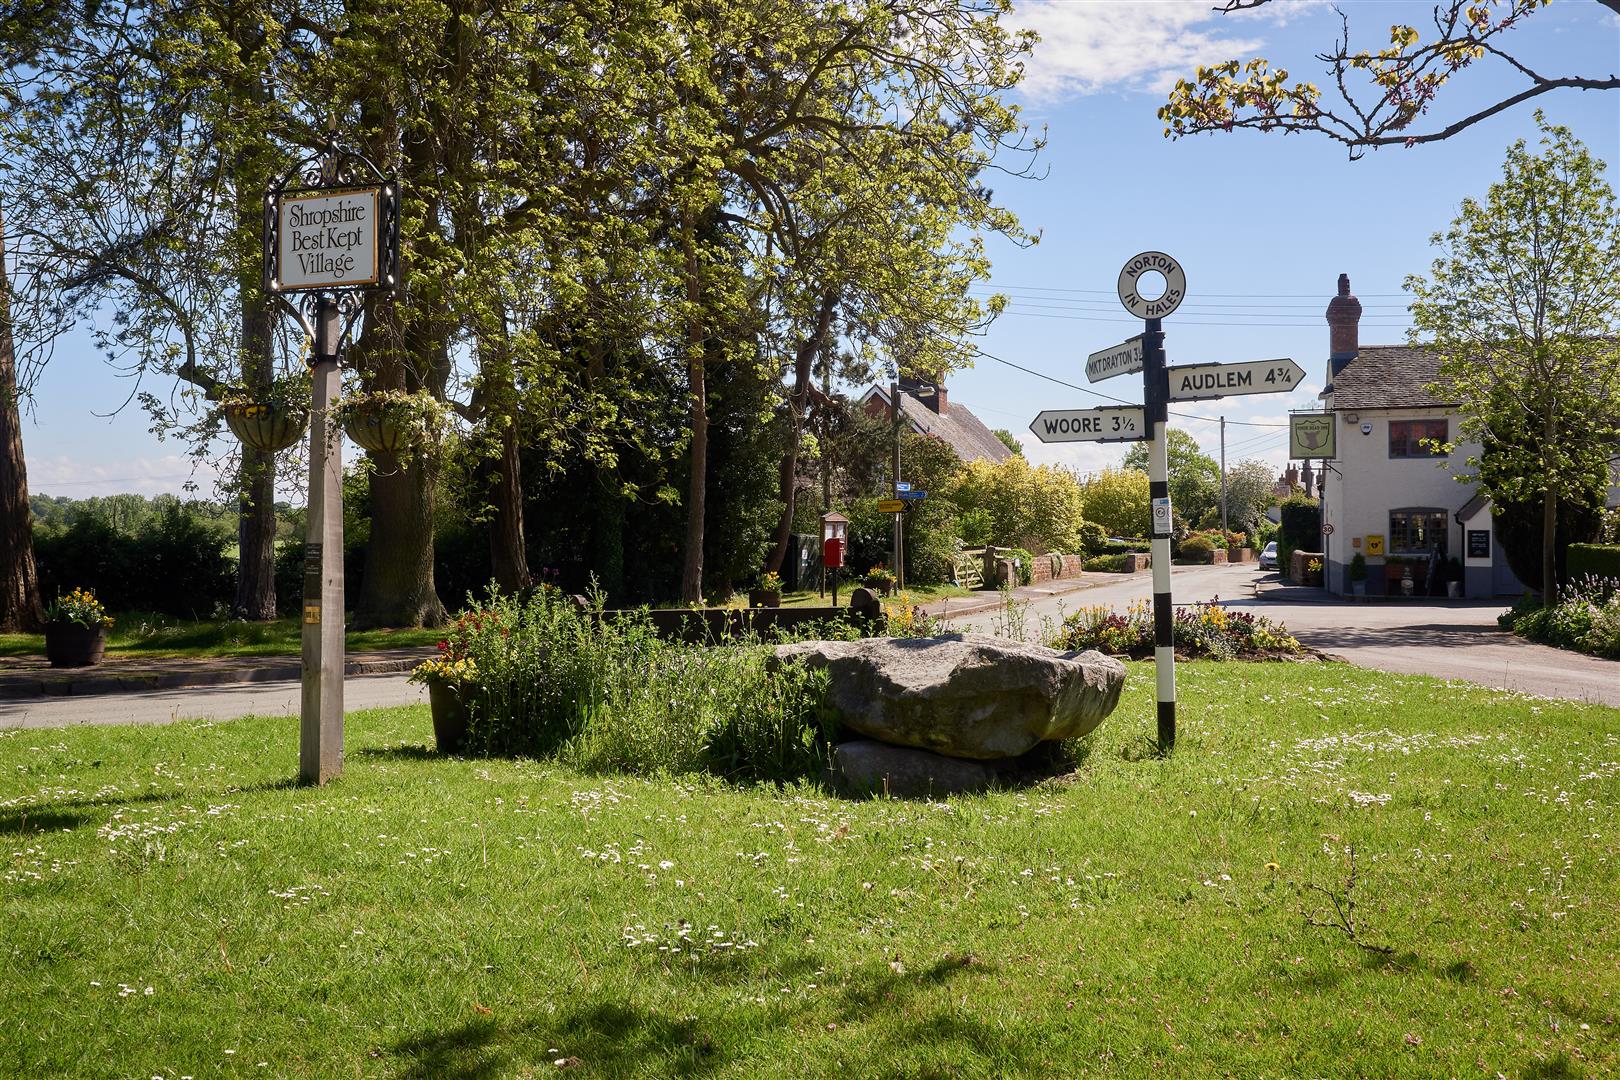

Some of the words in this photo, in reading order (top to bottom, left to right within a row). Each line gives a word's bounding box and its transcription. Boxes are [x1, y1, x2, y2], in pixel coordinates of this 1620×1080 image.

[289, 200, 366, 228] Shropshire
[291, 230, 325, 251] Best
[326, 226, 363, 251] Kept
[298, 253, 355, 279] Village
[1126, 255, 1176, 278] NORTON
[1124, 293, 1140, 309] IN
[1145, 288, 1181, 316] HALES
[1088, 359, 1102, 377] MKT
[1102, 349, 1133, 372] DRAYTON
[1180, 370, 1252, 392] AUDLEM
[1043, 416, 1103, 435] WOORE
